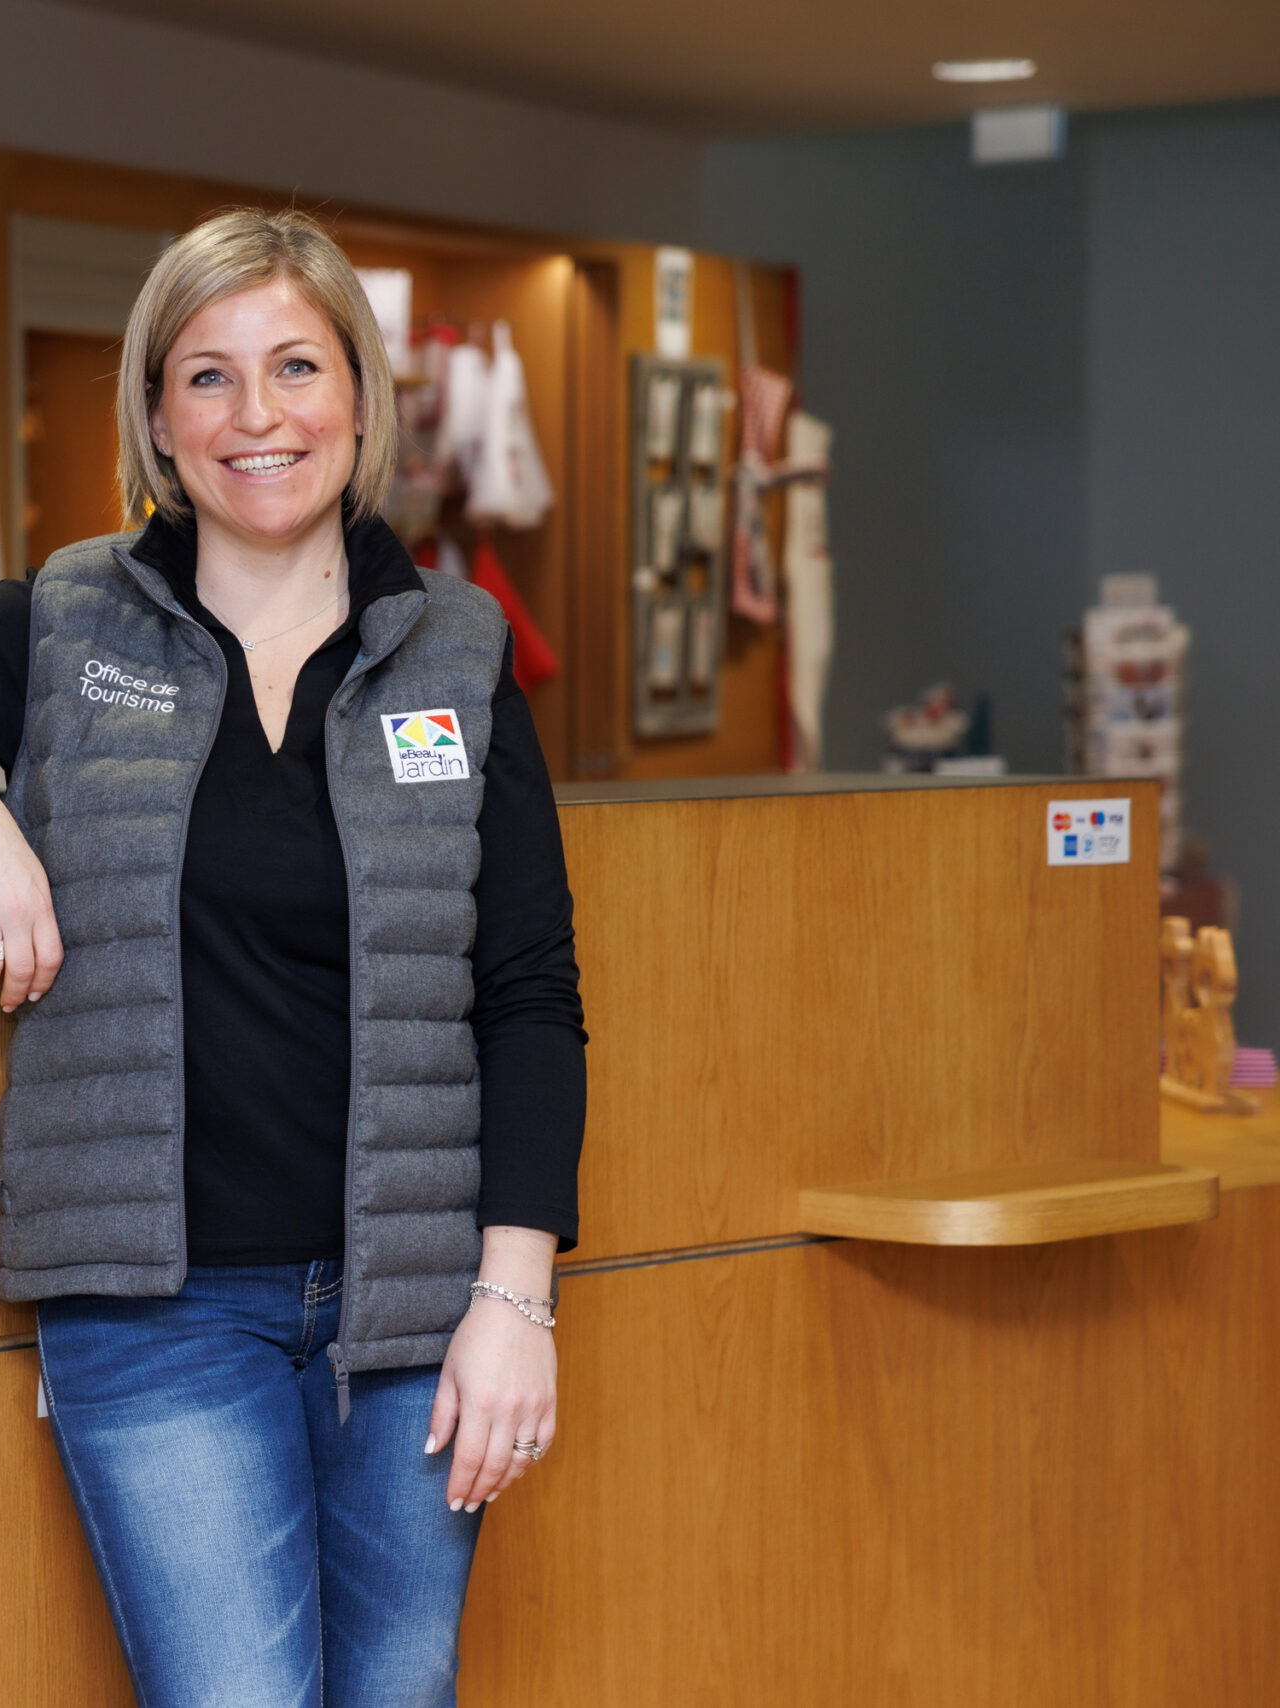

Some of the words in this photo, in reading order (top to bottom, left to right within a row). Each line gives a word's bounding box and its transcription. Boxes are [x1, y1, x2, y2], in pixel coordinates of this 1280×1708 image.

[79, 676, 175, 713] Tourisme
[84, 659, 147, 690] Office
[150, 682, 180, 696] de
[398, 753, 464, 779] Jardin
